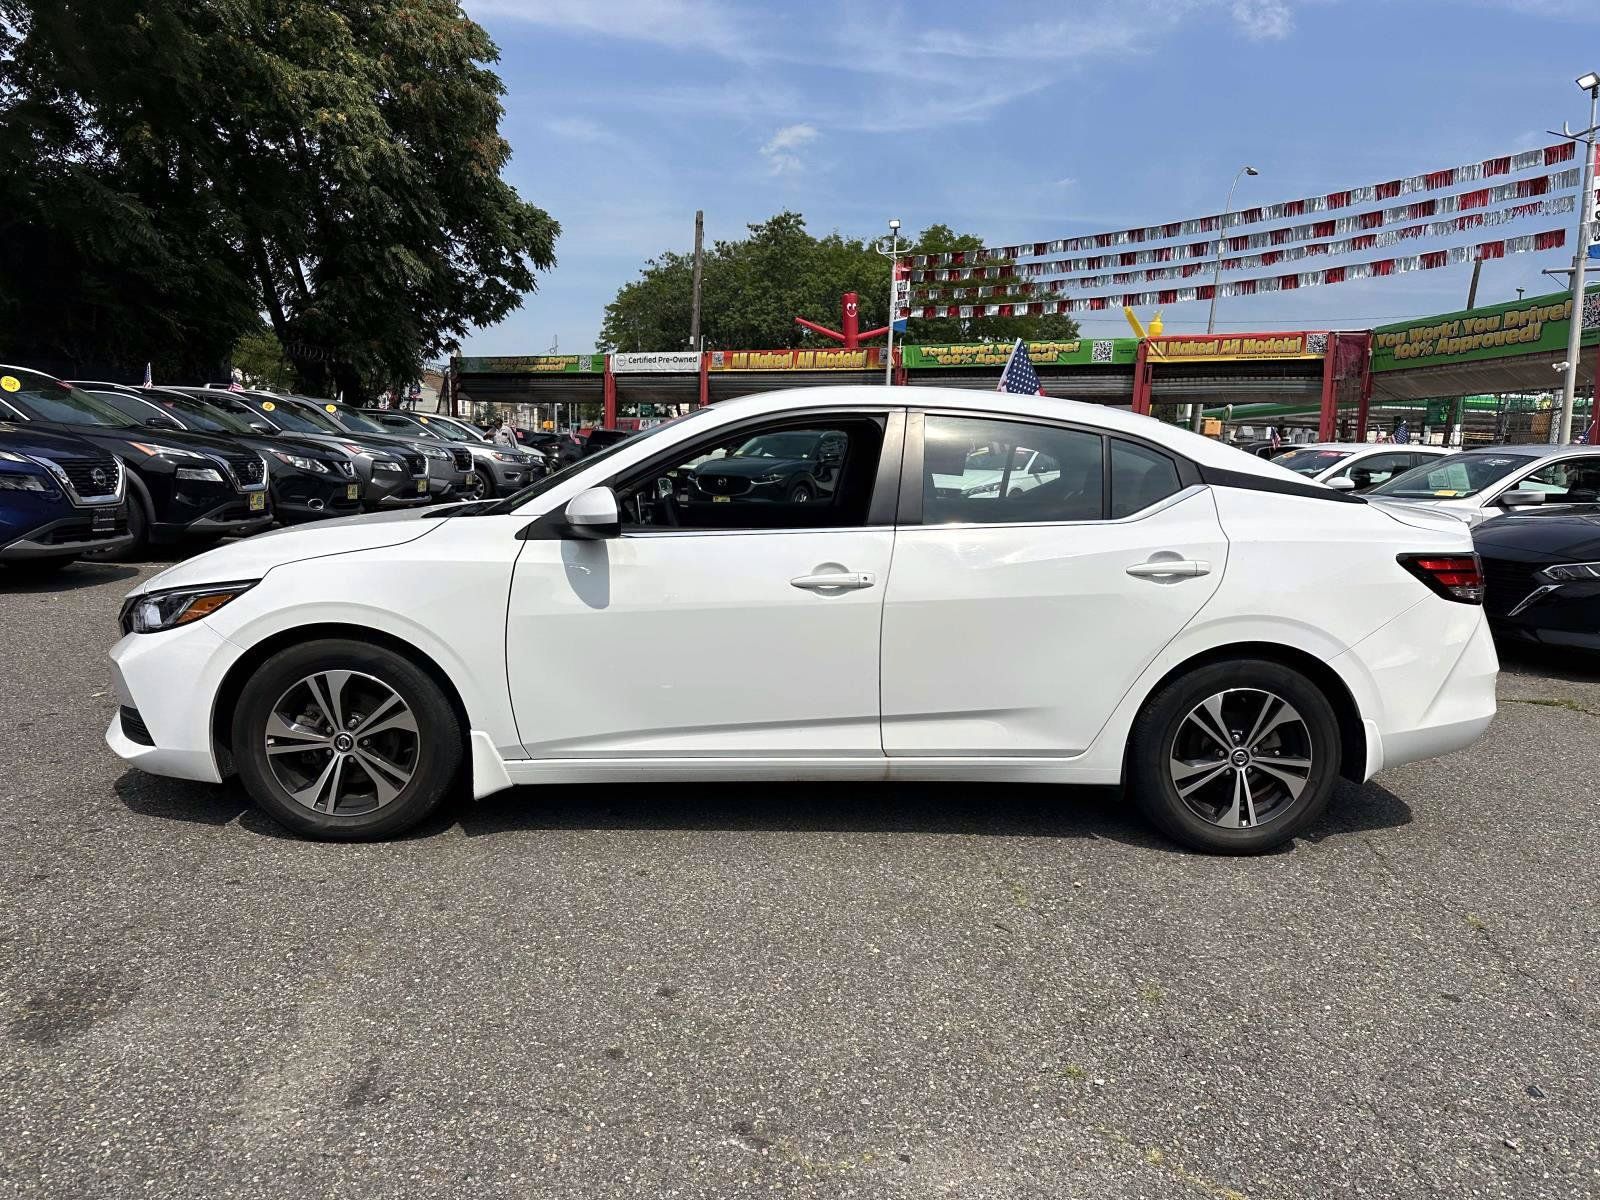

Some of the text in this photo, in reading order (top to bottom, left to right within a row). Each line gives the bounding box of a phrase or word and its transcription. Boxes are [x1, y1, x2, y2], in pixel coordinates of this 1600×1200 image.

[1376, 299, 1573, 349] You Work! You Drive!
[920, 346, 948, 357] You
[949, 344, 994, 355] Work!
[1030, 341, 1080, 353] Drive!
[1168, 339, 1220, 356] Makes!
[1220, 338, 1242, 355] All
[1242, 336, 1302, 354] Models!
[1393, 321, 1544, 360] 100% Approved!
[628, 355, 657, 364] Certified
[658, 354, 698, 364] Pre-Owned
[731, 350, 868, 369] All Makes! All Models!
[937, 350, 1058, 365] 100% Apped!
